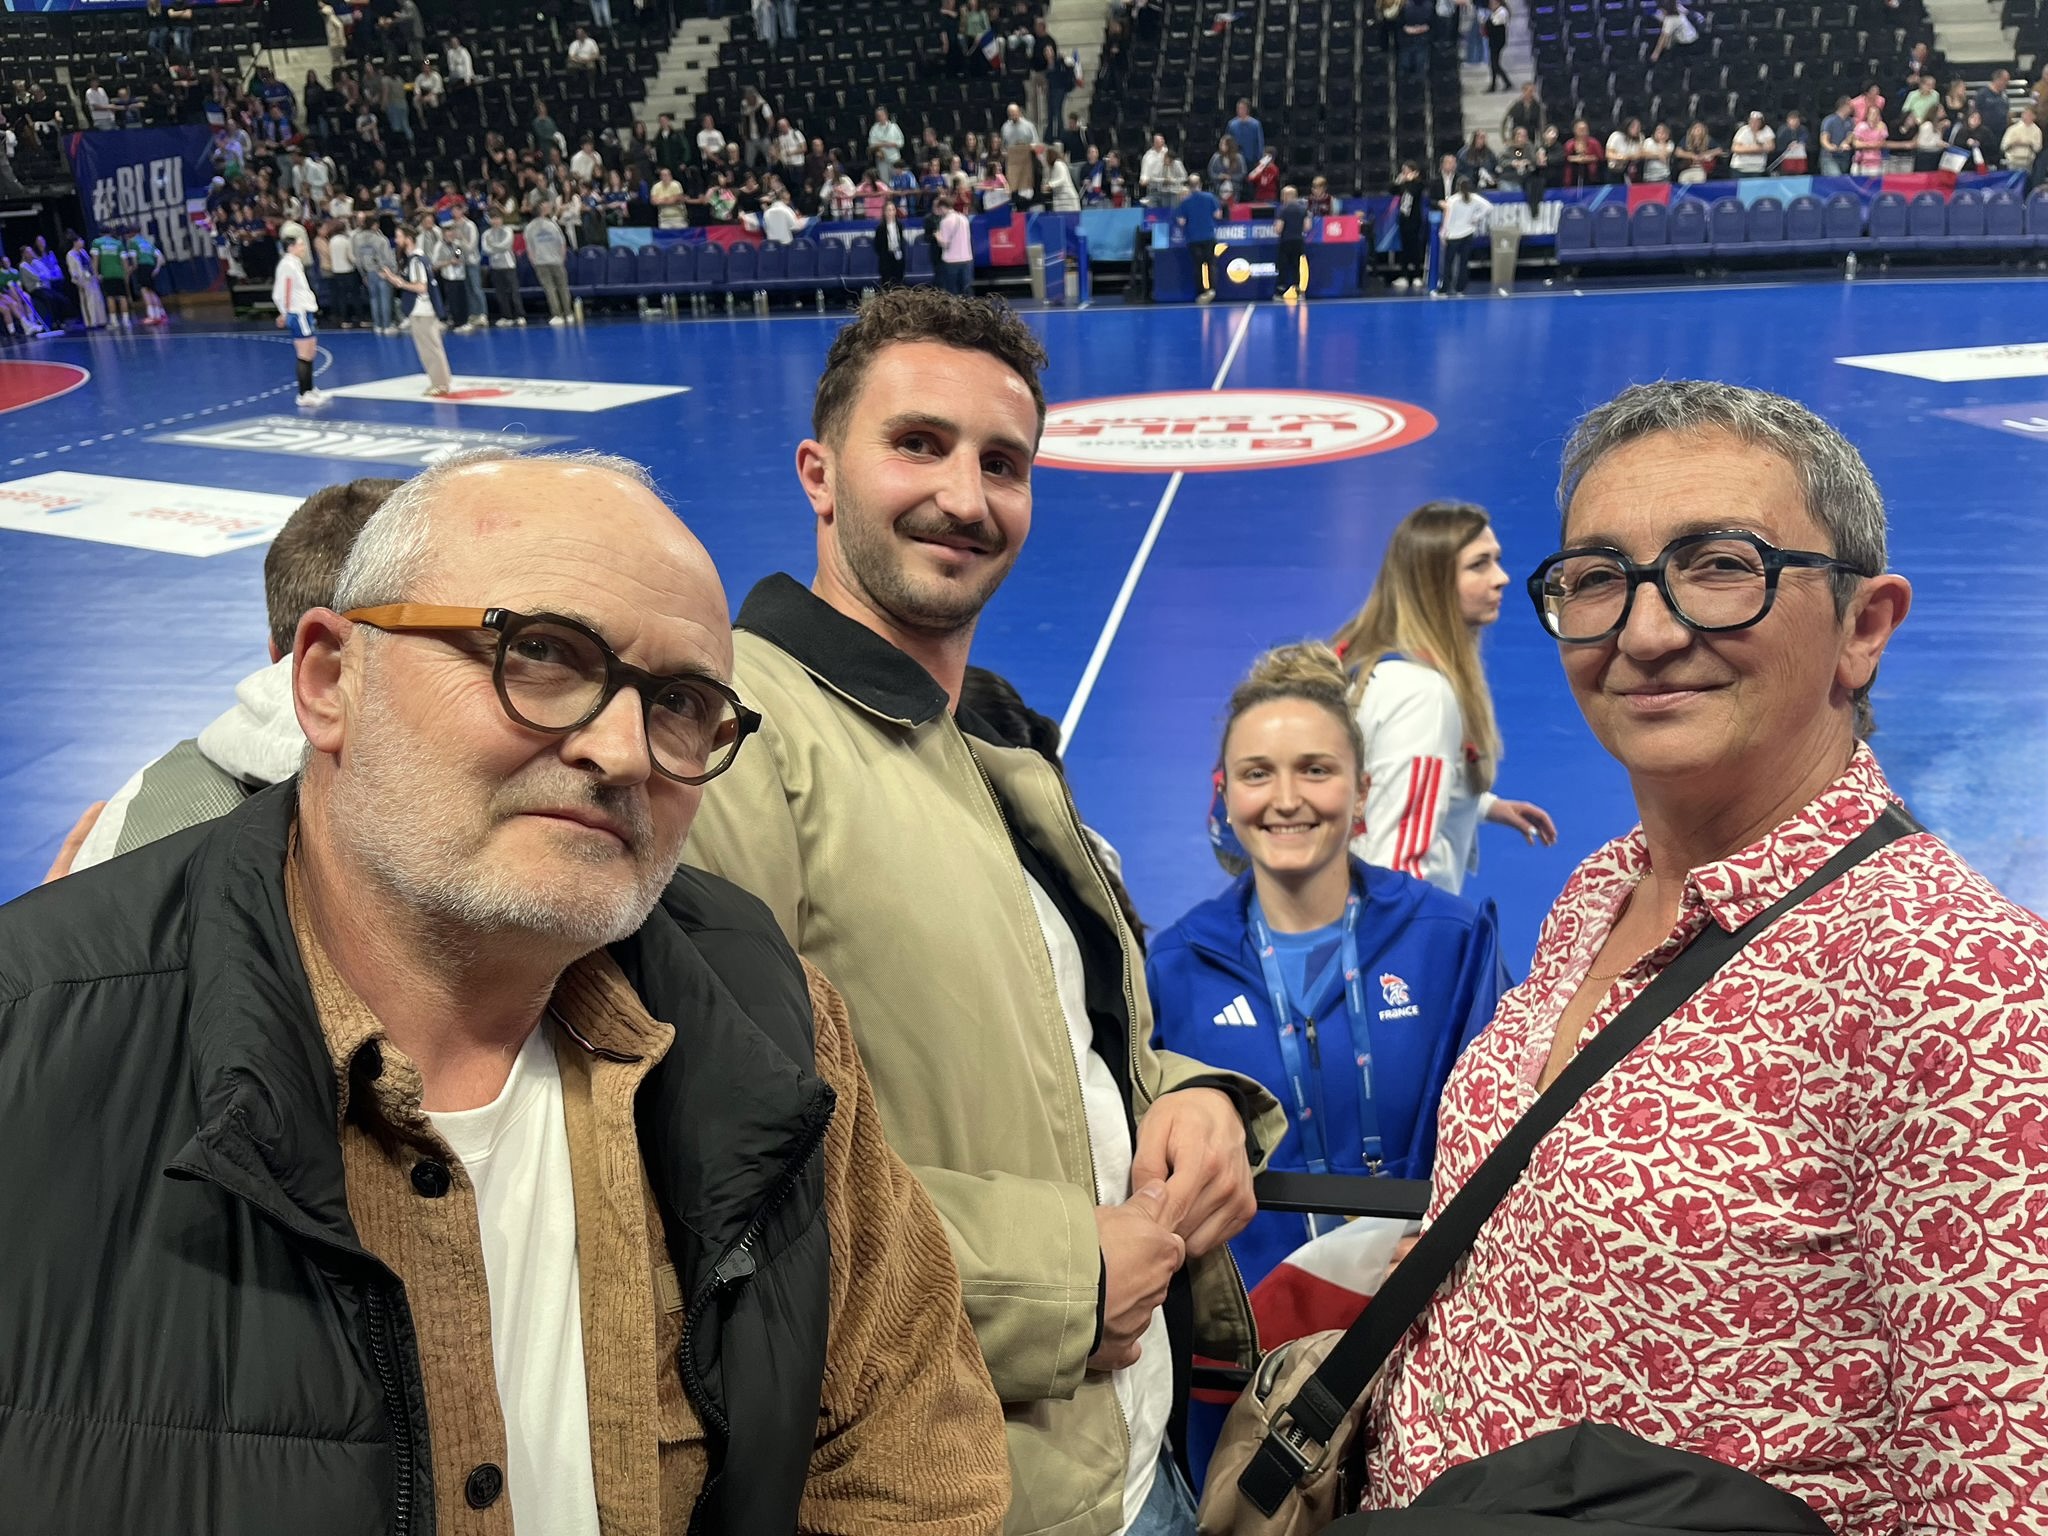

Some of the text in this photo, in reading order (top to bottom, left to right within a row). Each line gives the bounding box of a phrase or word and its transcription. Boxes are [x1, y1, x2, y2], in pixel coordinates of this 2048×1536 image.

[92, 156, 184, 222] #BLEU
[1059, 413, 1351, 424] AU SPORT
[1045, 421, 1358, 437] UTILE
